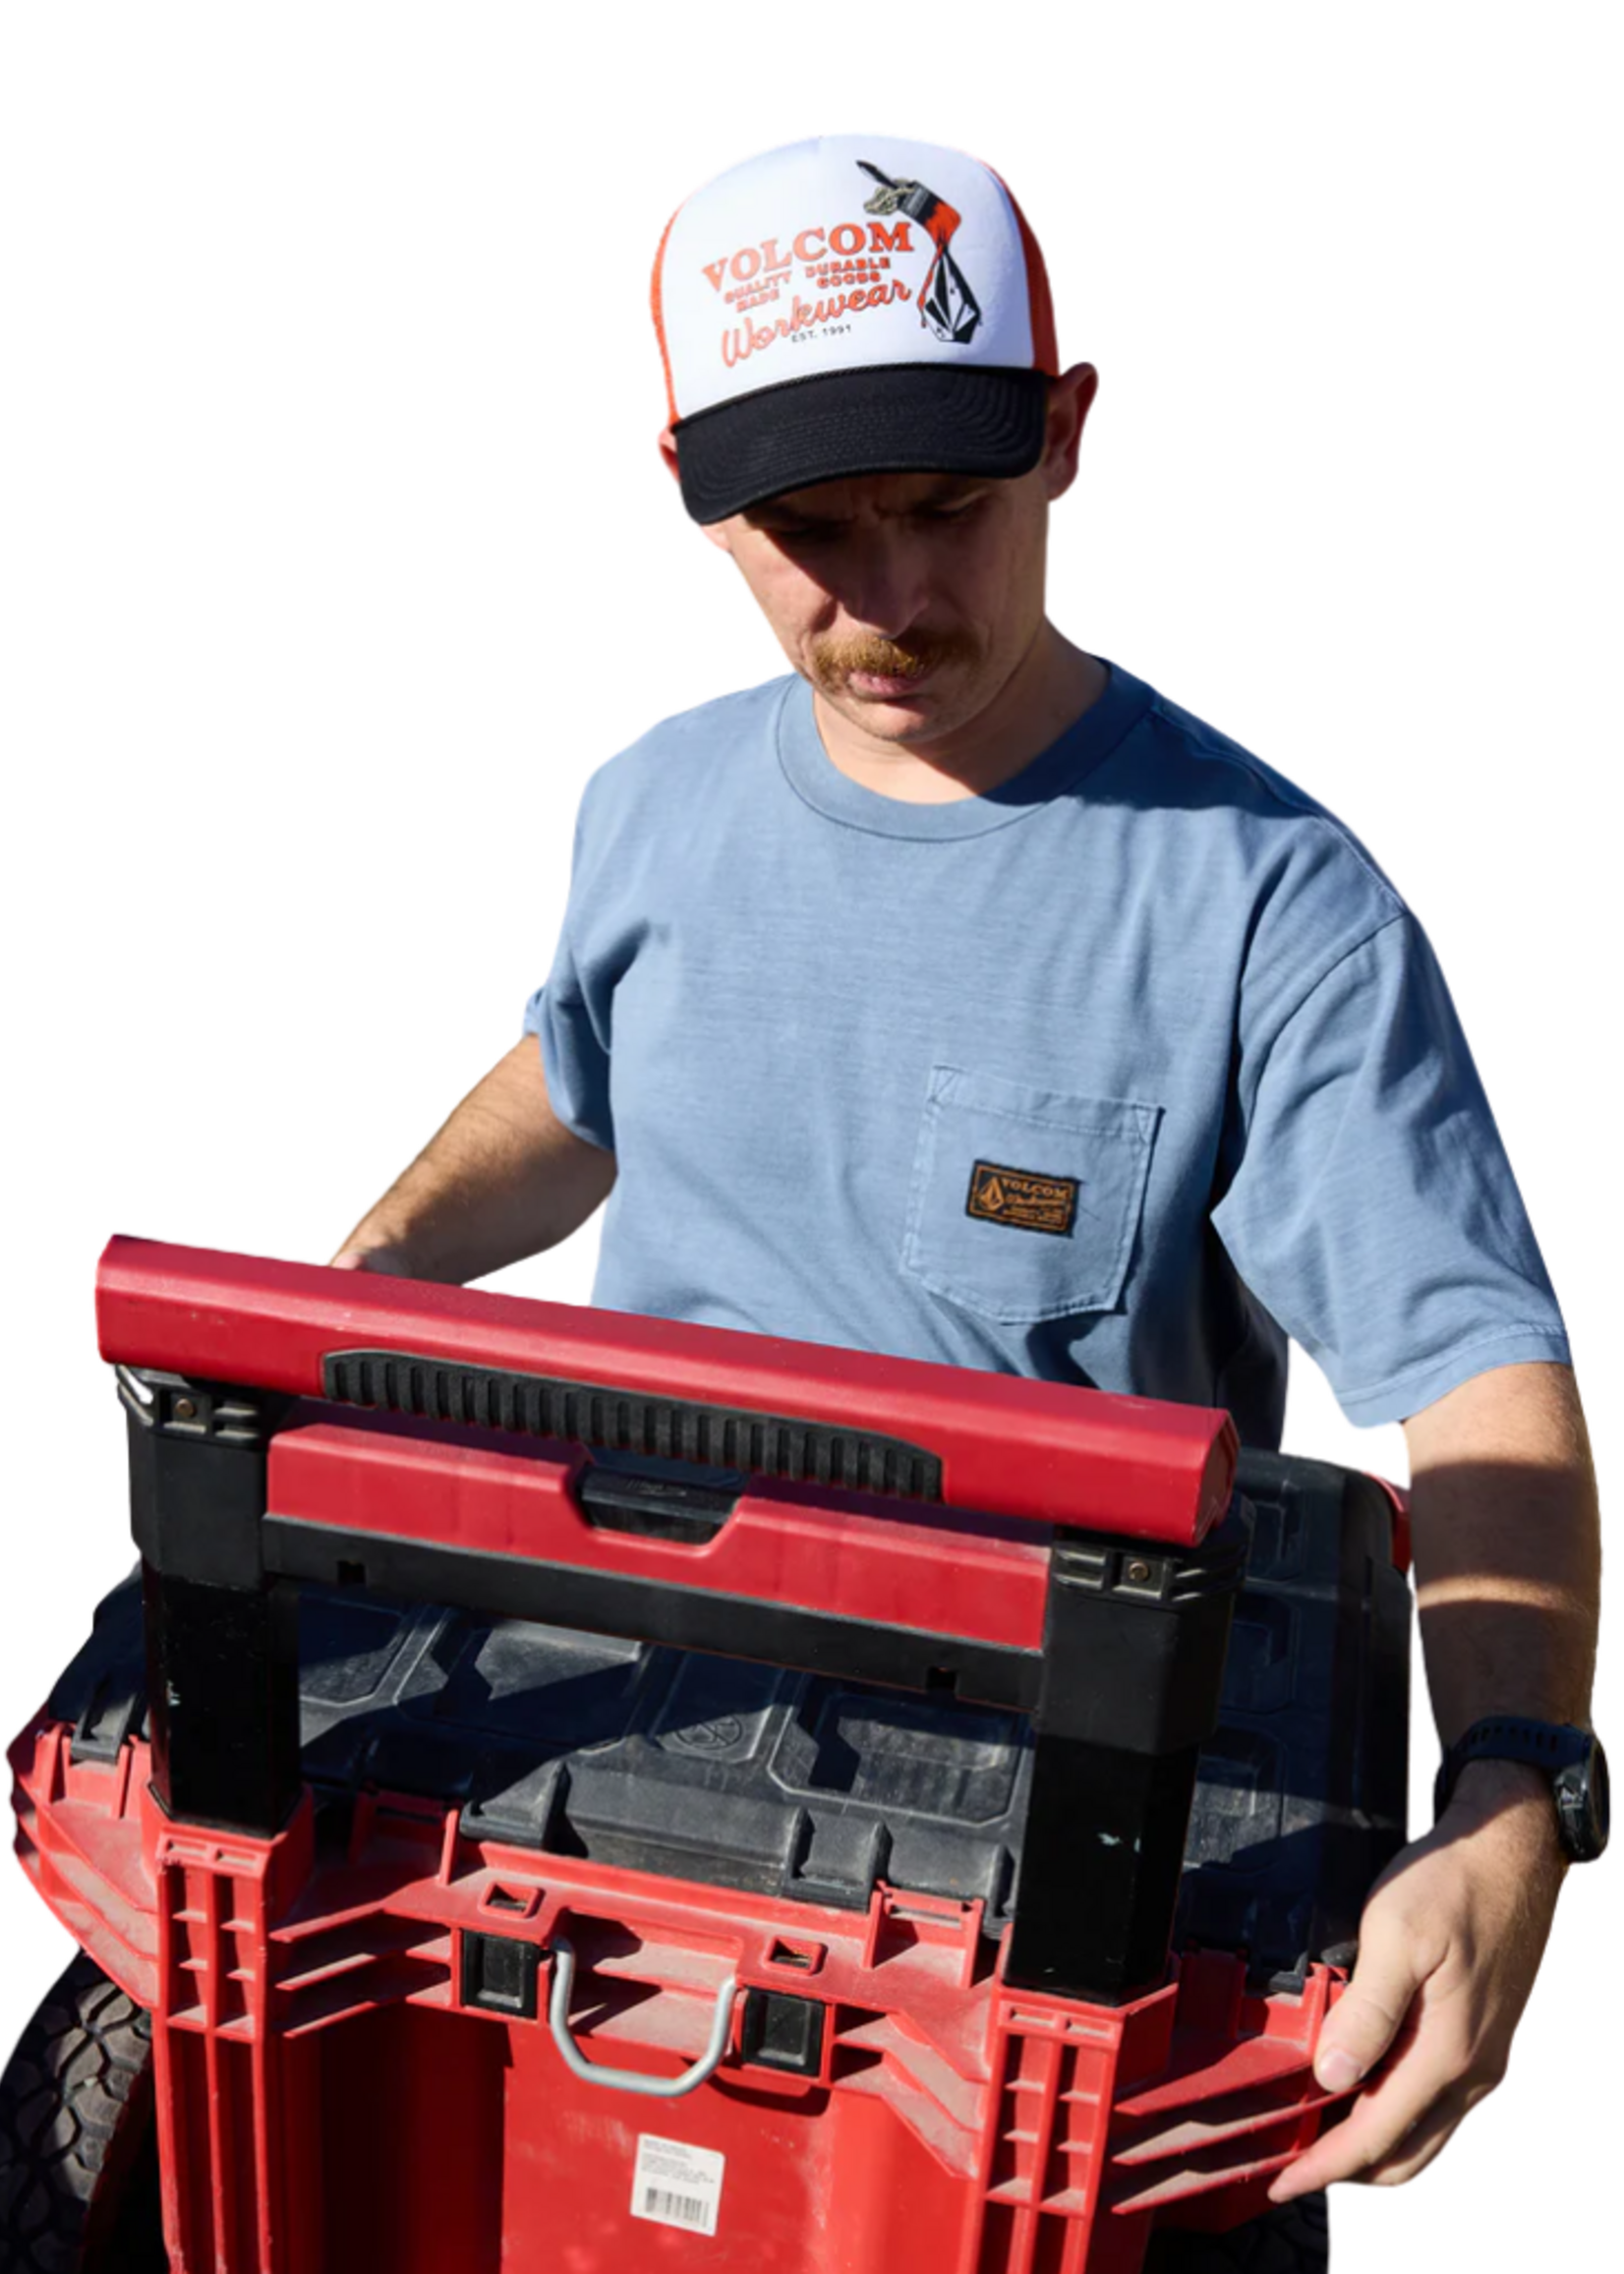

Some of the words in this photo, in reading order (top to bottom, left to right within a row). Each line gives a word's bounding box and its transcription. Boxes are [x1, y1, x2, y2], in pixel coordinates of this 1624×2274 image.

[702, 222, 914, 292] VOLCOM
[805, 257, 891, 278] DURABLE
[724, 271, 791, 304] QUALITY
[816, 270, 881, 289] GOODS
[722, 278, 912, 368] Workwear
[791, 329, 818, 343] EST.
[823, 323, 851, 337] 1991
[1002, 1178, 1069, 1198] VOLCOM
